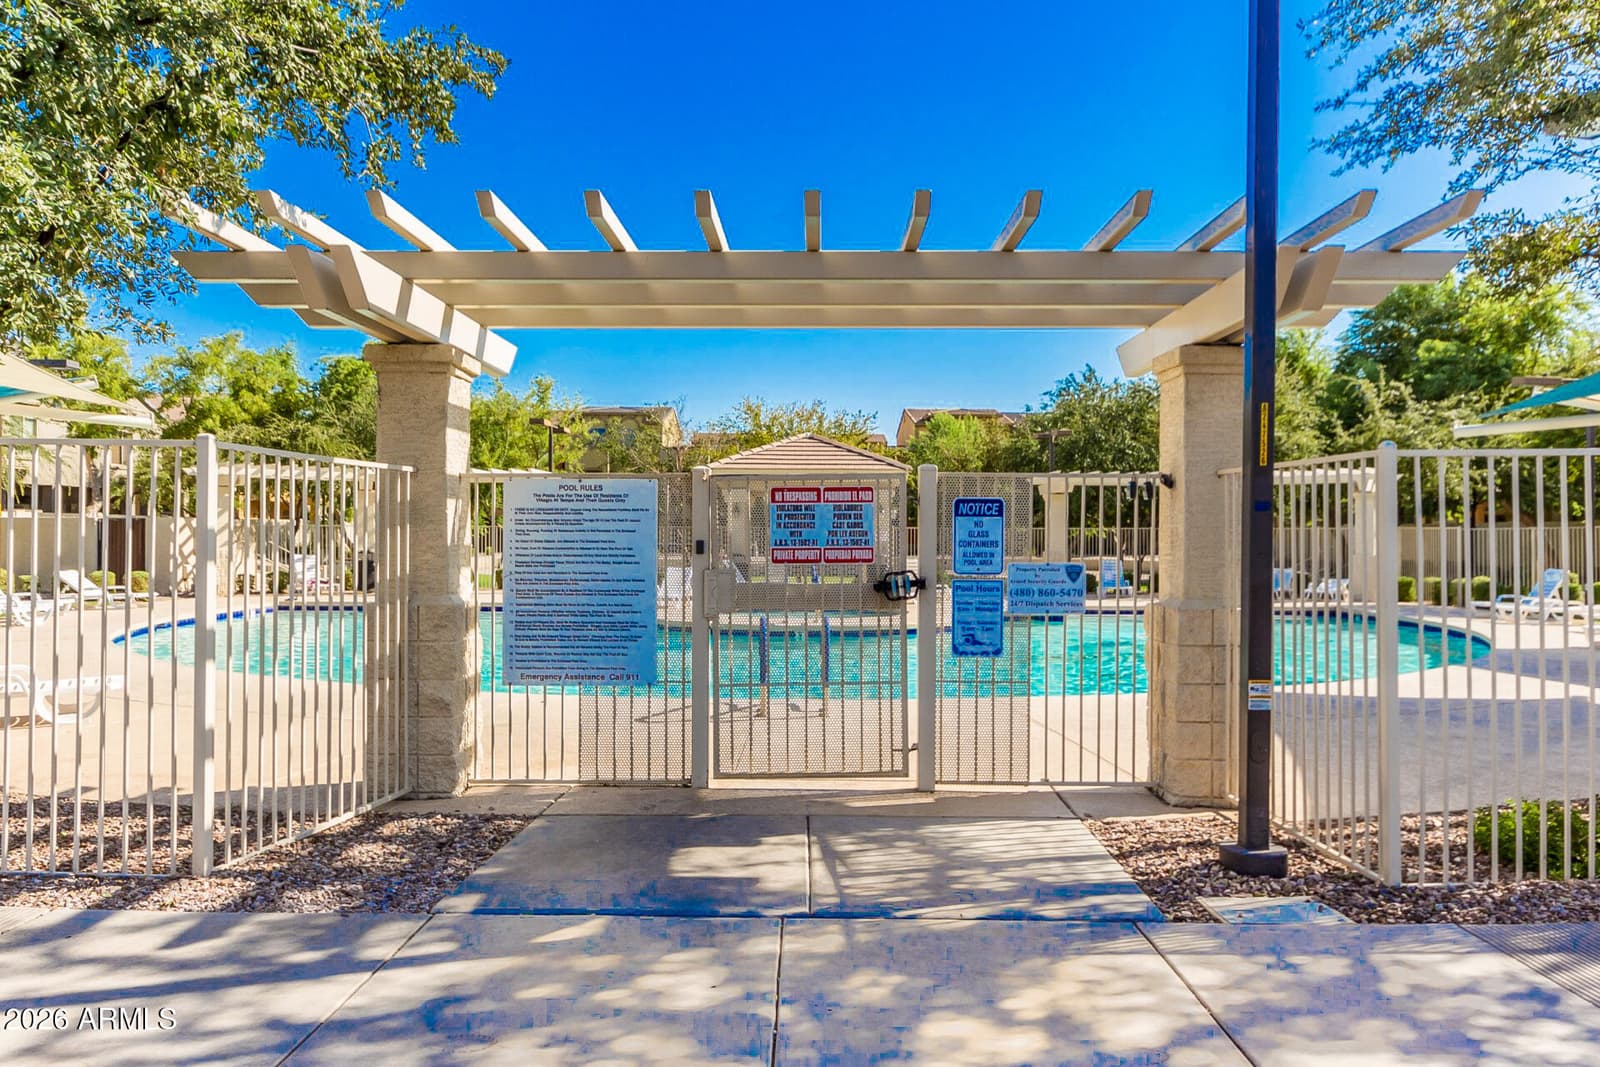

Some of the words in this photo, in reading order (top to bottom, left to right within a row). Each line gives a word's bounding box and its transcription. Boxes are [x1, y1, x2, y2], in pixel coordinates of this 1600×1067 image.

[775, 491, 782, 501] NO
[784, 491, 817, 501] TRESPASSING
[852, 491, 858, 501] EL
[859, 491, 872, 501] PASO
[958, 503, 999, 515] NOTICE
[774, 550, 794, 560] PRIVATE
[795, 550, 820, 560] PROPERTY
[1010, 588, 1035, 598] (480)
[1038, 588, 1083, 597] 860-5470
[520, 673, 561, 681] Emergency
